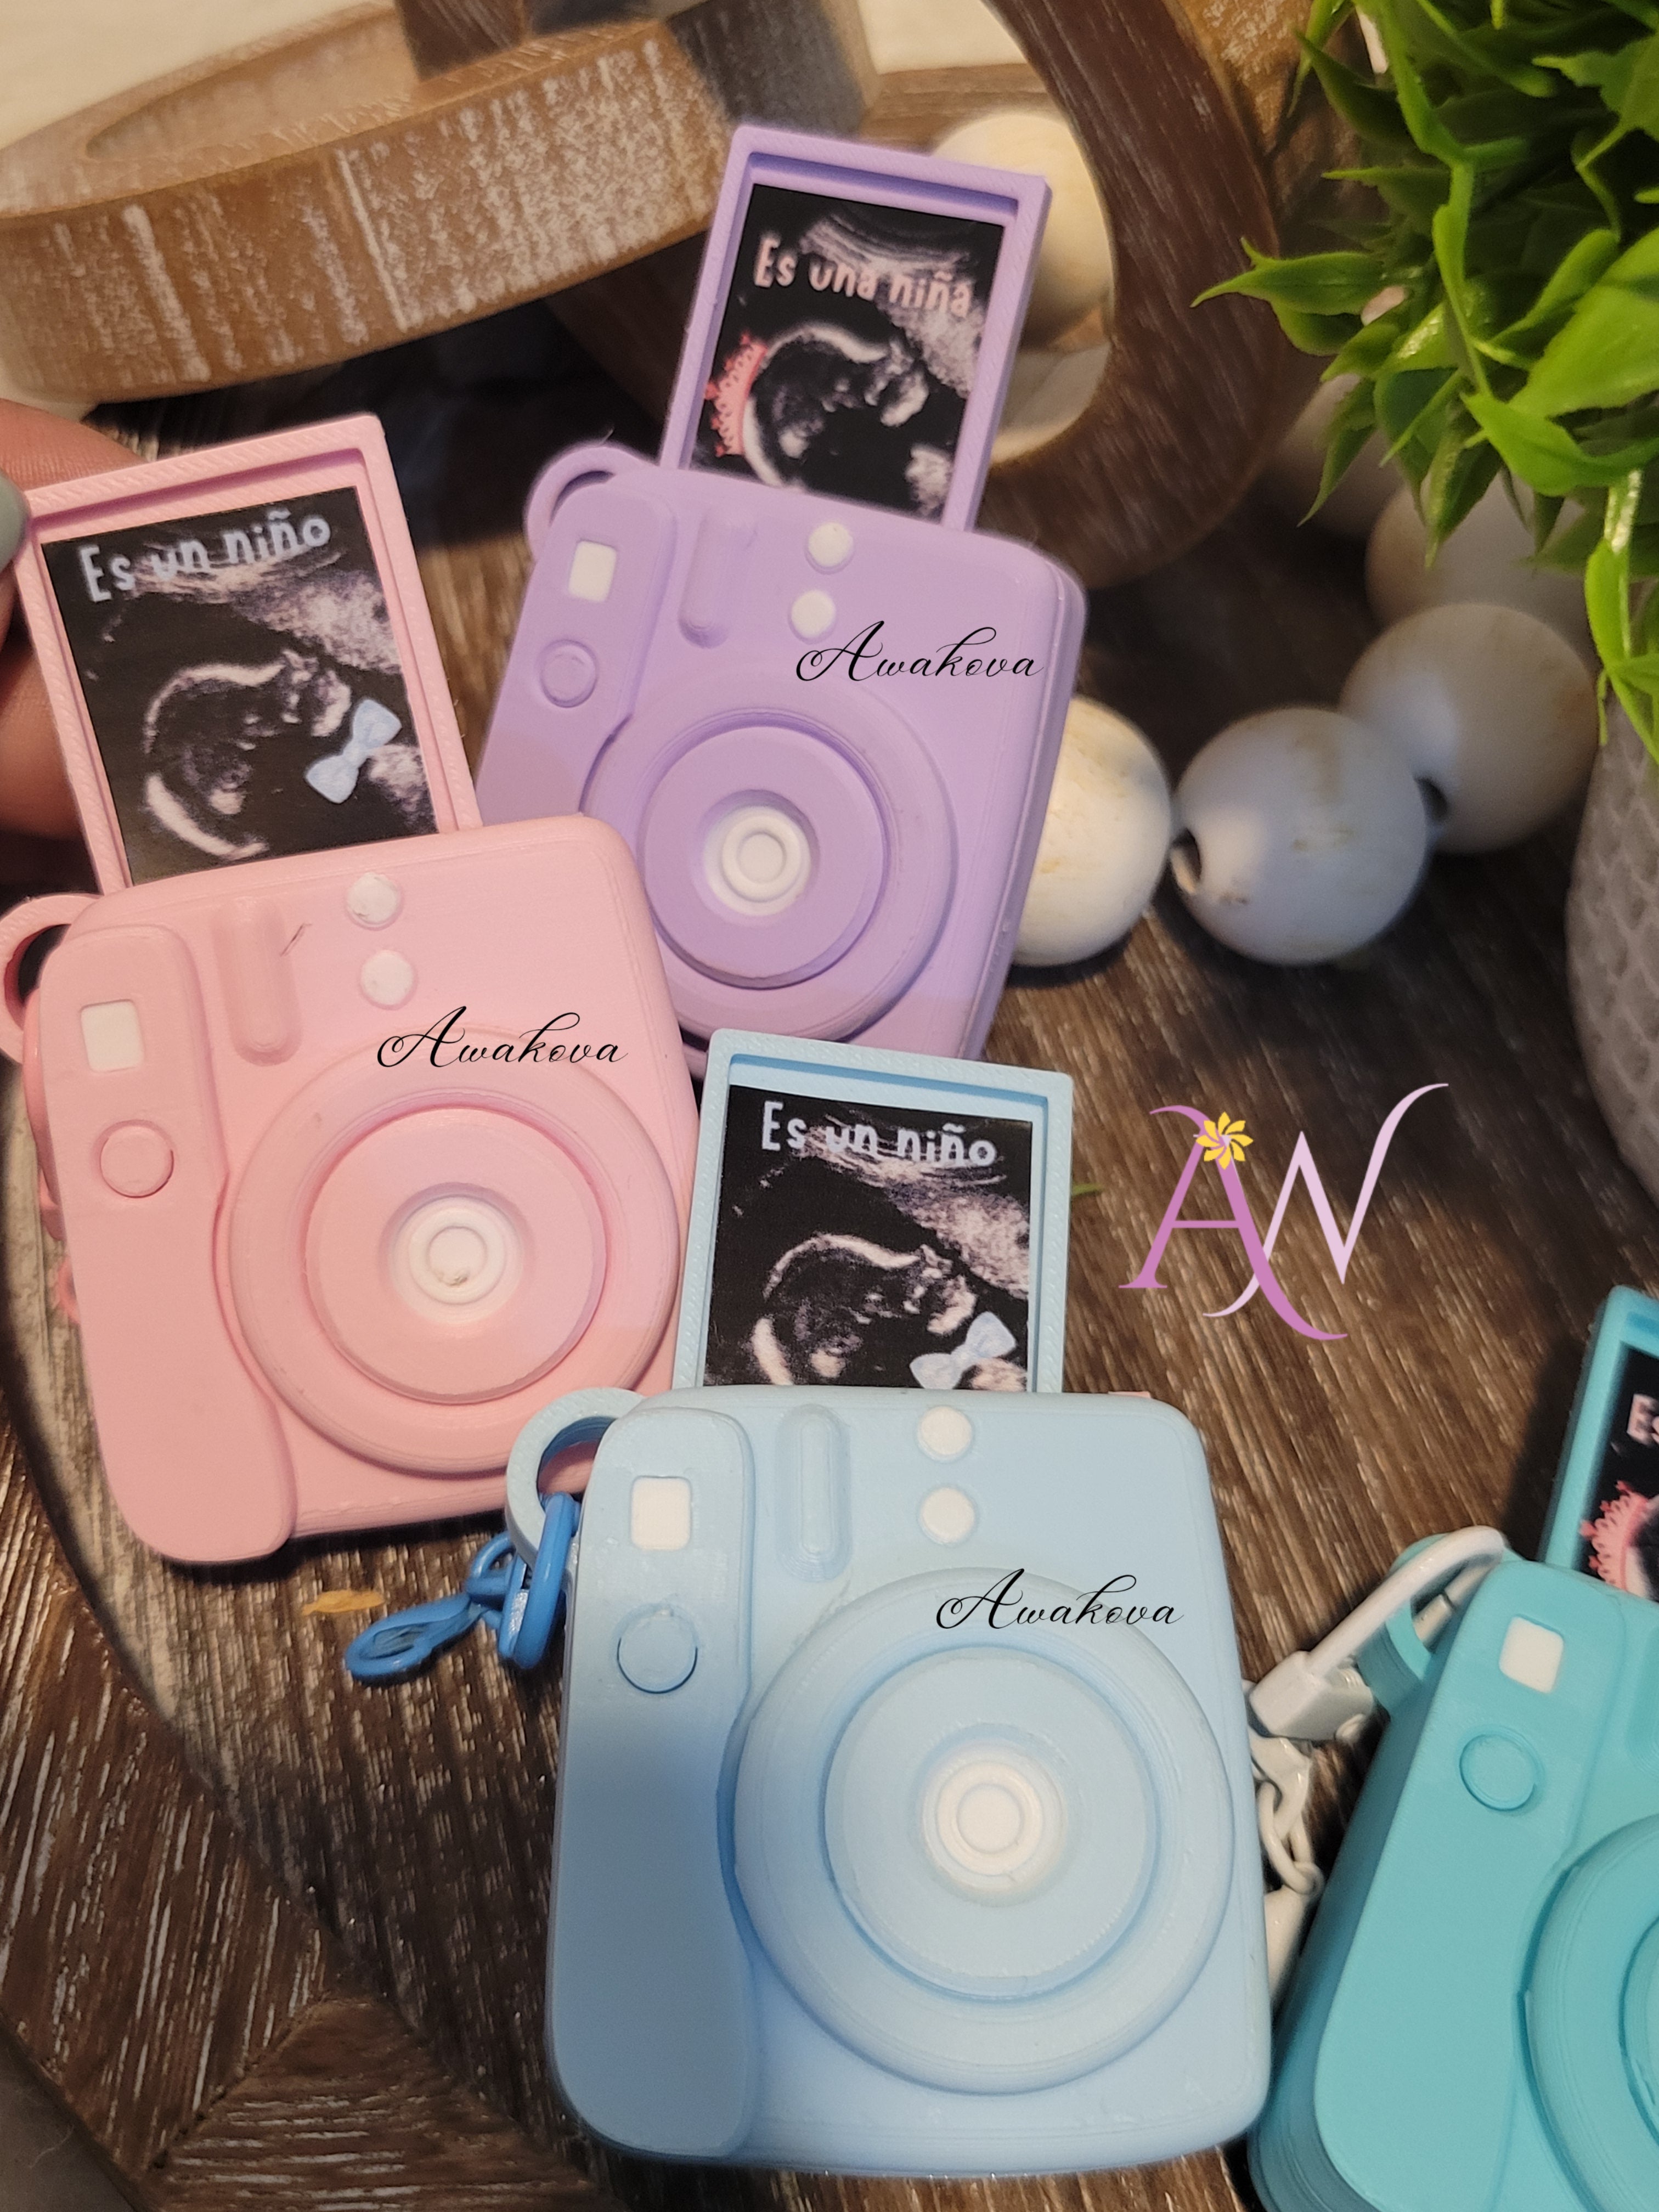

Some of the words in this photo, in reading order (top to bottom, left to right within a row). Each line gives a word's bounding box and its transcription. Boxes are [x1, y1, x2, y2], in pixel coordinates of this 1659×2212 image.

[754, 234, 798, 288] Es
[809, 260, 878, 301] una
[888, 270, 974, 318] niña
[78, 544, 136, 603] Es
[150, 539, 212, 580] un
[223, 507, 331, 565] niño
[761, 1100, 808, 1152] Es
[825, 1123, 878, 1154] un
[896, 1122, 997, 1167] niño
